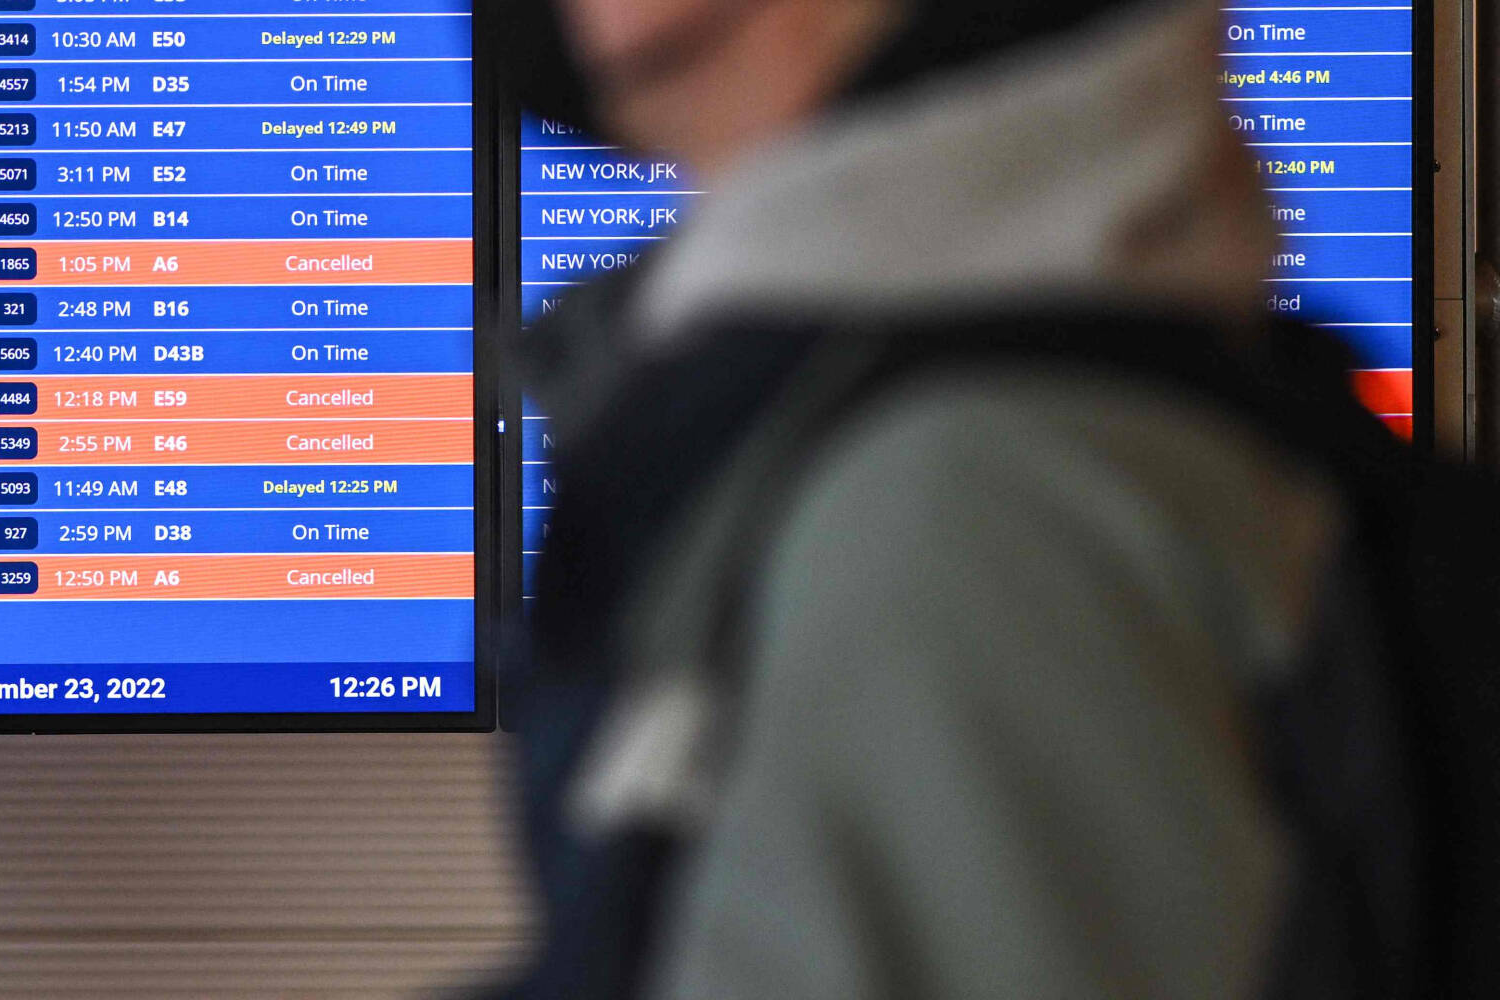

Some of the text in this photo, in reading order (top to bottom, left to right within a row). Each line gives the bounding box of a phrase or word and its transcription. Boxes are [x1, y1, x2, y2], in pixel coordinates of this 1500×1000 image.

[541, 163, 677, 183] NEW YORK, JFK
[1266, 160, 1335, 174] 12:40 PM
[53, 210, 136, 228] 12:50 PM
[153, 210, 189, 227] B14
[290, 209, 368, 226] On Time
[0, 482, 31, 495] 5093
[54, 480, 138, 497] 11:49 AM
[154, 479, 188, 496] E48
[263, 479, 398, 498] Delayed 12:25 PM
[64, 677, 100, 704] 23,
[106, 677, 166, 699] 2022
[329, 676, 441, 698] 12:26 PM
